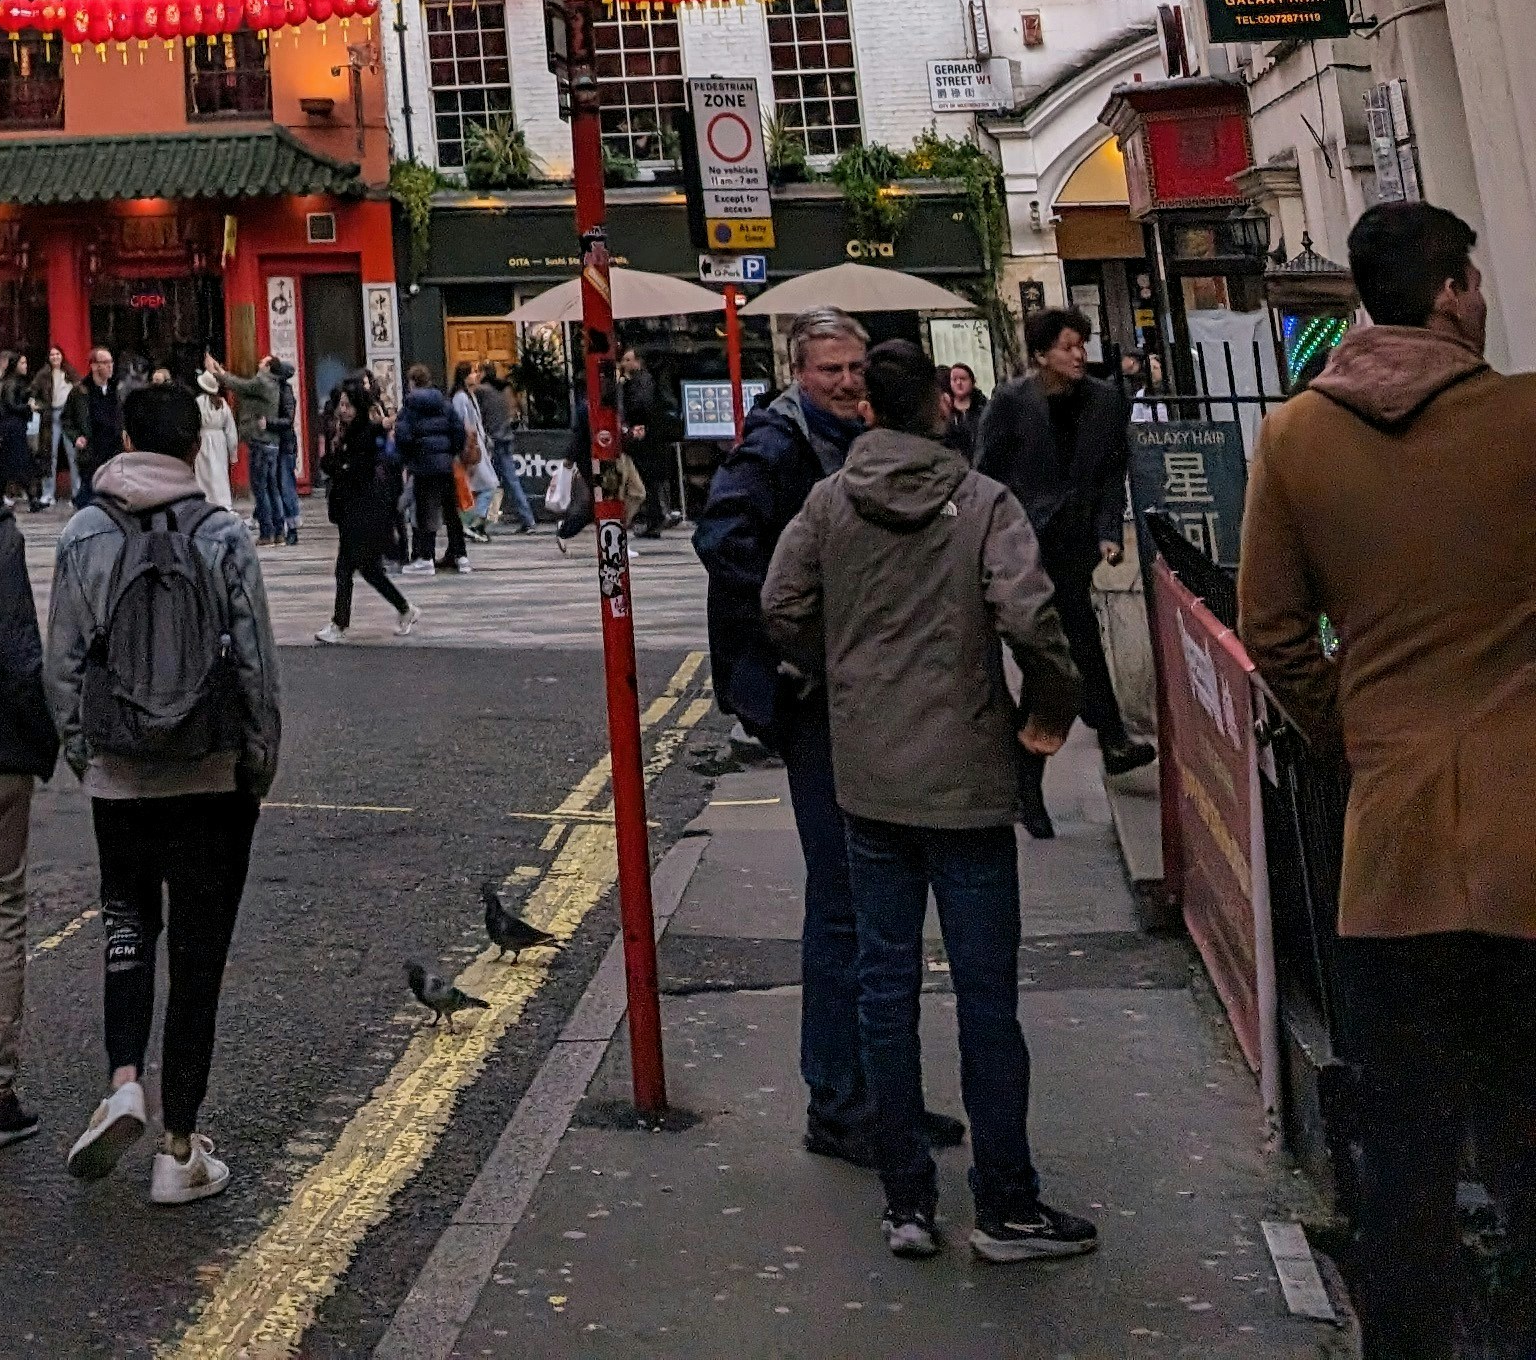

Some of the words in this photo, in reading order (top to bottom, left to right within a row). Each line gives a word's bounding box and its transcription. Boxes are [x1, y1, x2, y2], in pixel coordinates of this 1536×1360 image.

[934, 63, 982, 75] GERRARD
[935, 75, 973, 87] STREET
[975, 75, 992, 85] W1
[694, 82, 753, 92] PEDESTRIAN
[703, 93, 747, 108] ZONE
[708, 166, 722, 175] No
[723, 165, 759, 175] vehicles
[714, 194, 744, 205] Except
[746, 194, 759, 204] for
[723, 205, 753, 214] access
[951, 211, 964, 221] 47
[739, 224, 750, 232] At
[751, 225, 766, 234] any
[846, 239, 894, 259] Oita
[508, 257, 530, 267] OITA
[746, 259, 760, 277] P
[130, 294, 165, 309] OPEN
[1137, 431, 1189, 445] GALAXY
[1192, 430, 1226, 445] HAIR
